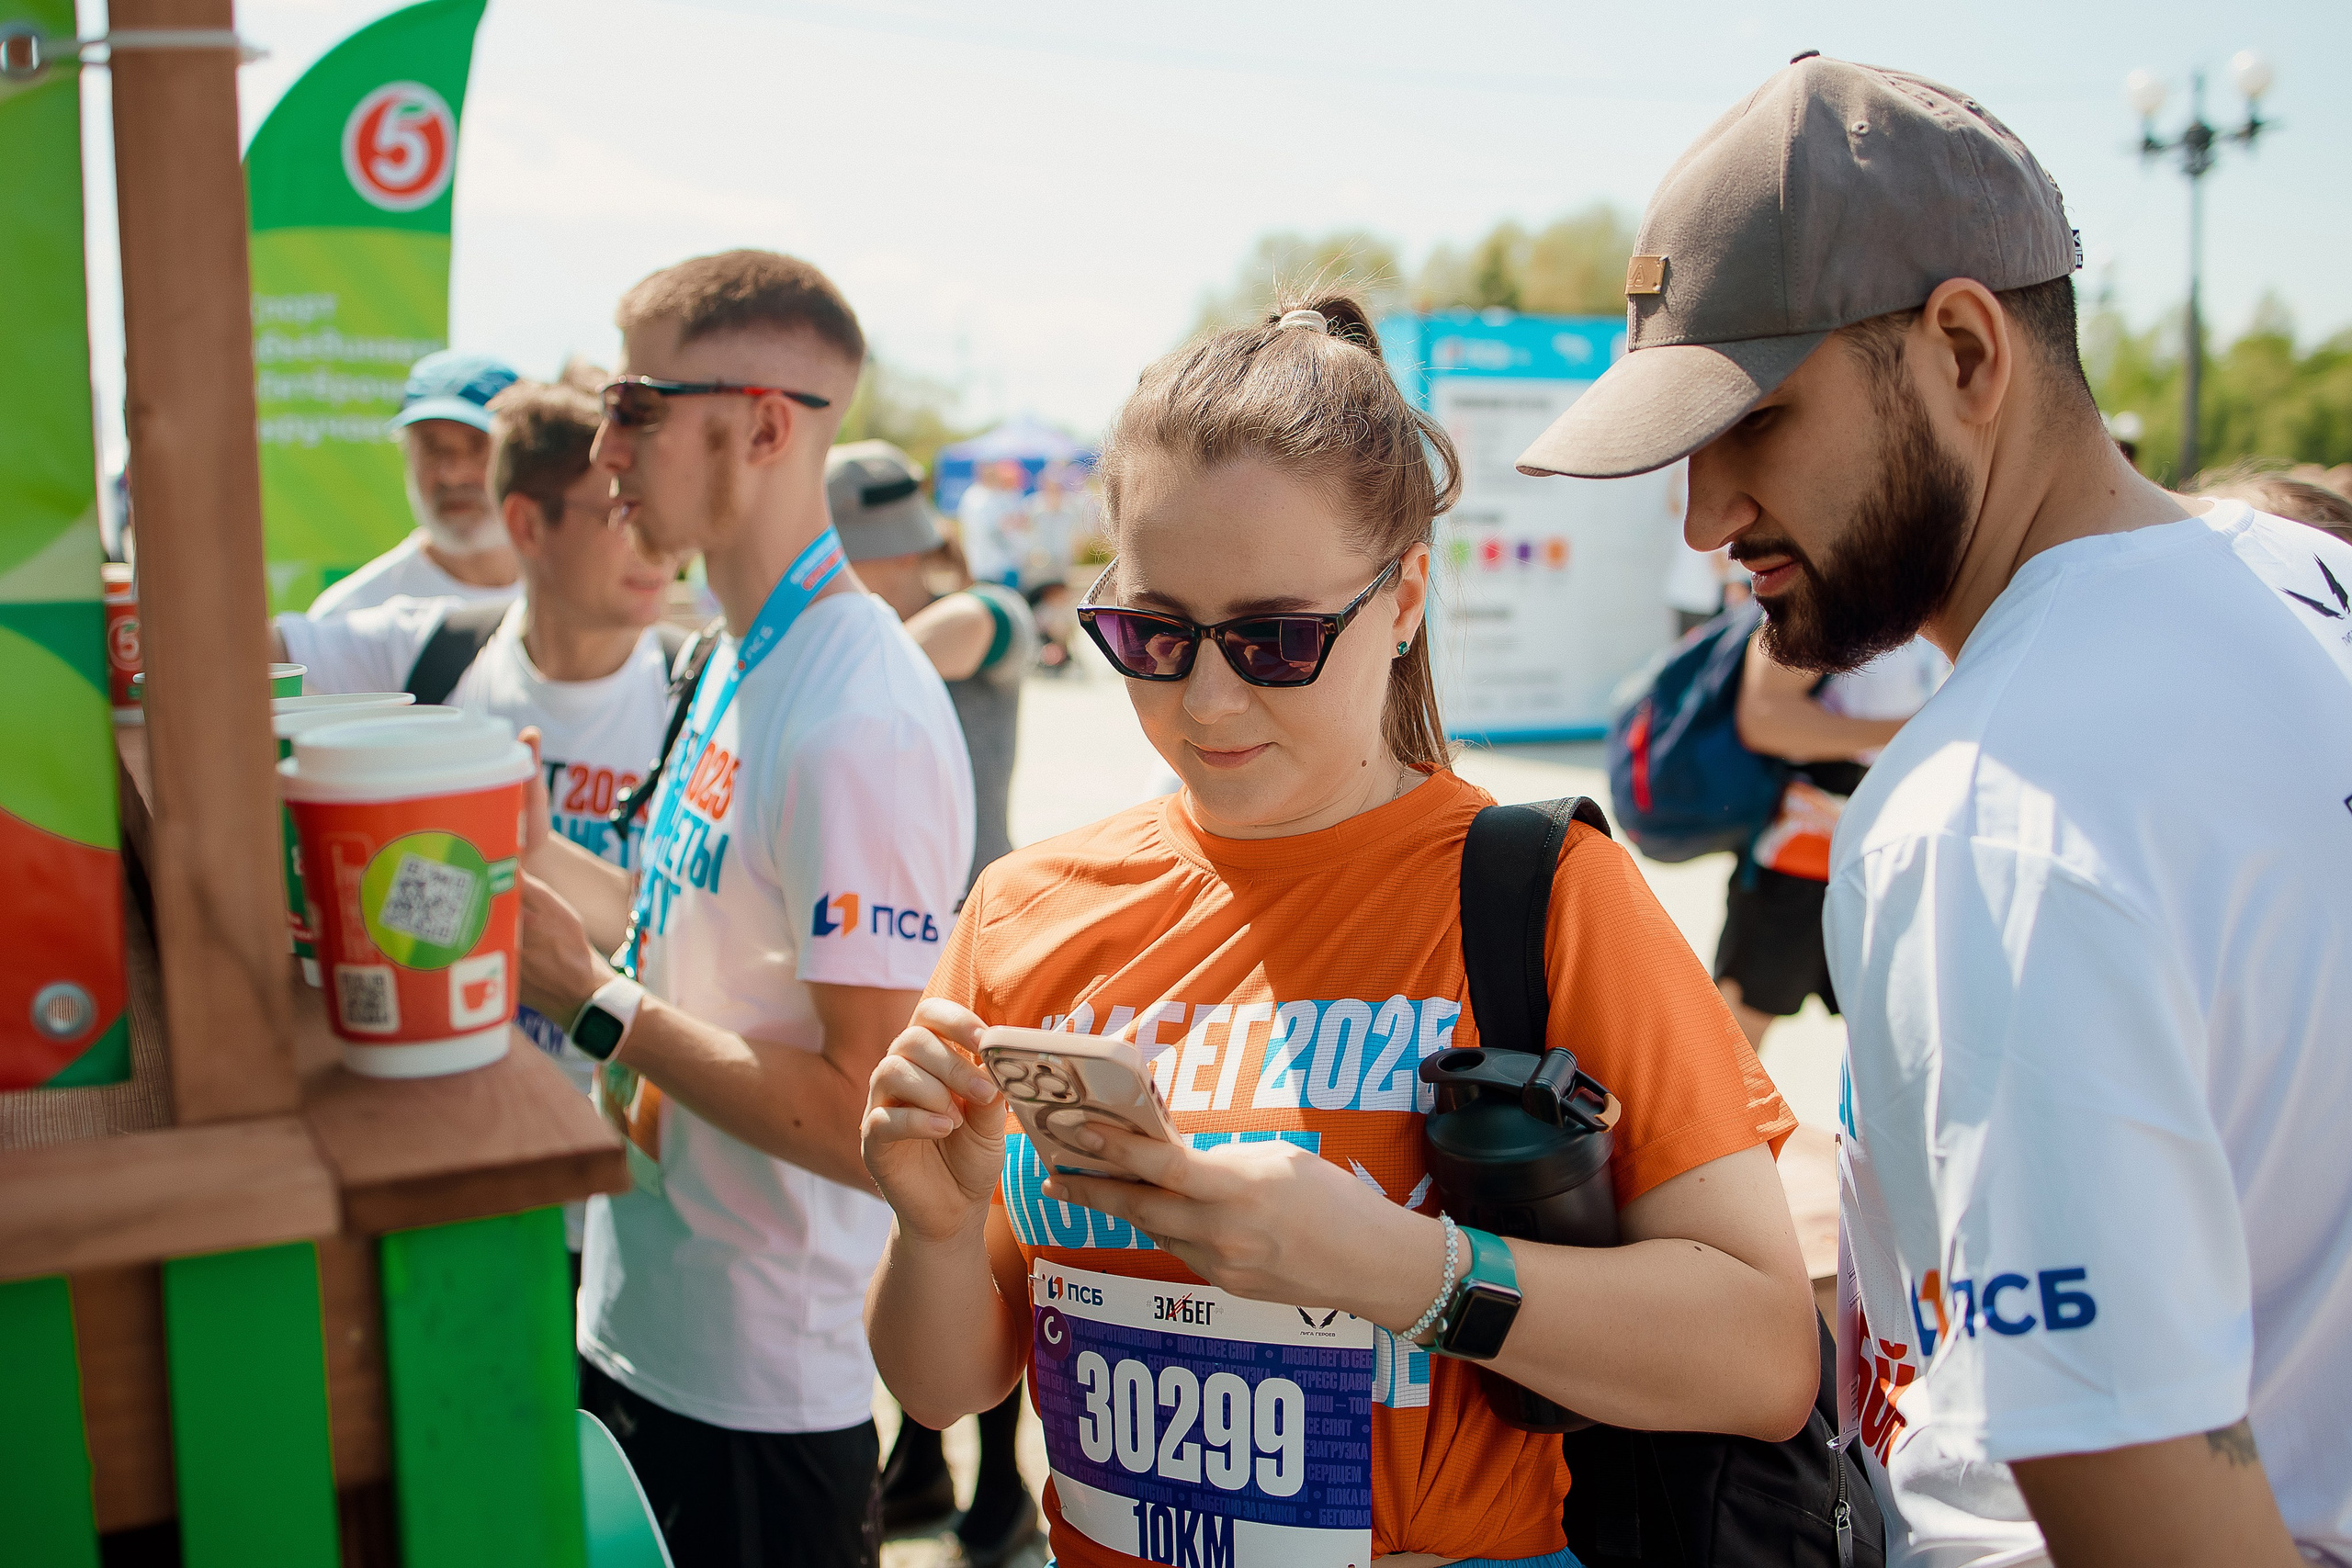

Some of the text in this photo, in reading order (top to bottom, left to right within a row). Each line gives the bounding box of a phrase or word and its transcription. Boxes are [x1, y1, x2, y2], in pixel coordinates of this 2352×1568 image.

[370, 97, 435, 183] 5
[871, 905, 938, 942] ПСБ
[1068, 1282, 1102, 1306] ПСБ
[1177, 1336, 1257, 1361] ПОКА ВСЕ СПЯТ
[1282, 1347, 1317, 1366] ЛЮБИ
[1318, 1348, 1340, 1368] БЕГ
[1341, 1350, 1350, 1368] В
[1293, 1370, 1338, 1390] СТРЕСС
[1078, 1350, 1305, 1497] 30299
[1321, 1418, 1353, 1437] СПЯТ
[1306, 1463, 1362, 1484] СЕРДЦЕМ
[1136, 1481, 1173, 1505] ОТСТАЛ
[1326, 1487, 1359, 1506] ПОКА
[1192, 1492, 1297, 1524] ВЫБЕГАЮ ЗА РАМКИ
[1318, 1508, 1371, 1527] БЕГОВАЯ
[1133, 1499, 1234, 1568] 10КМ
